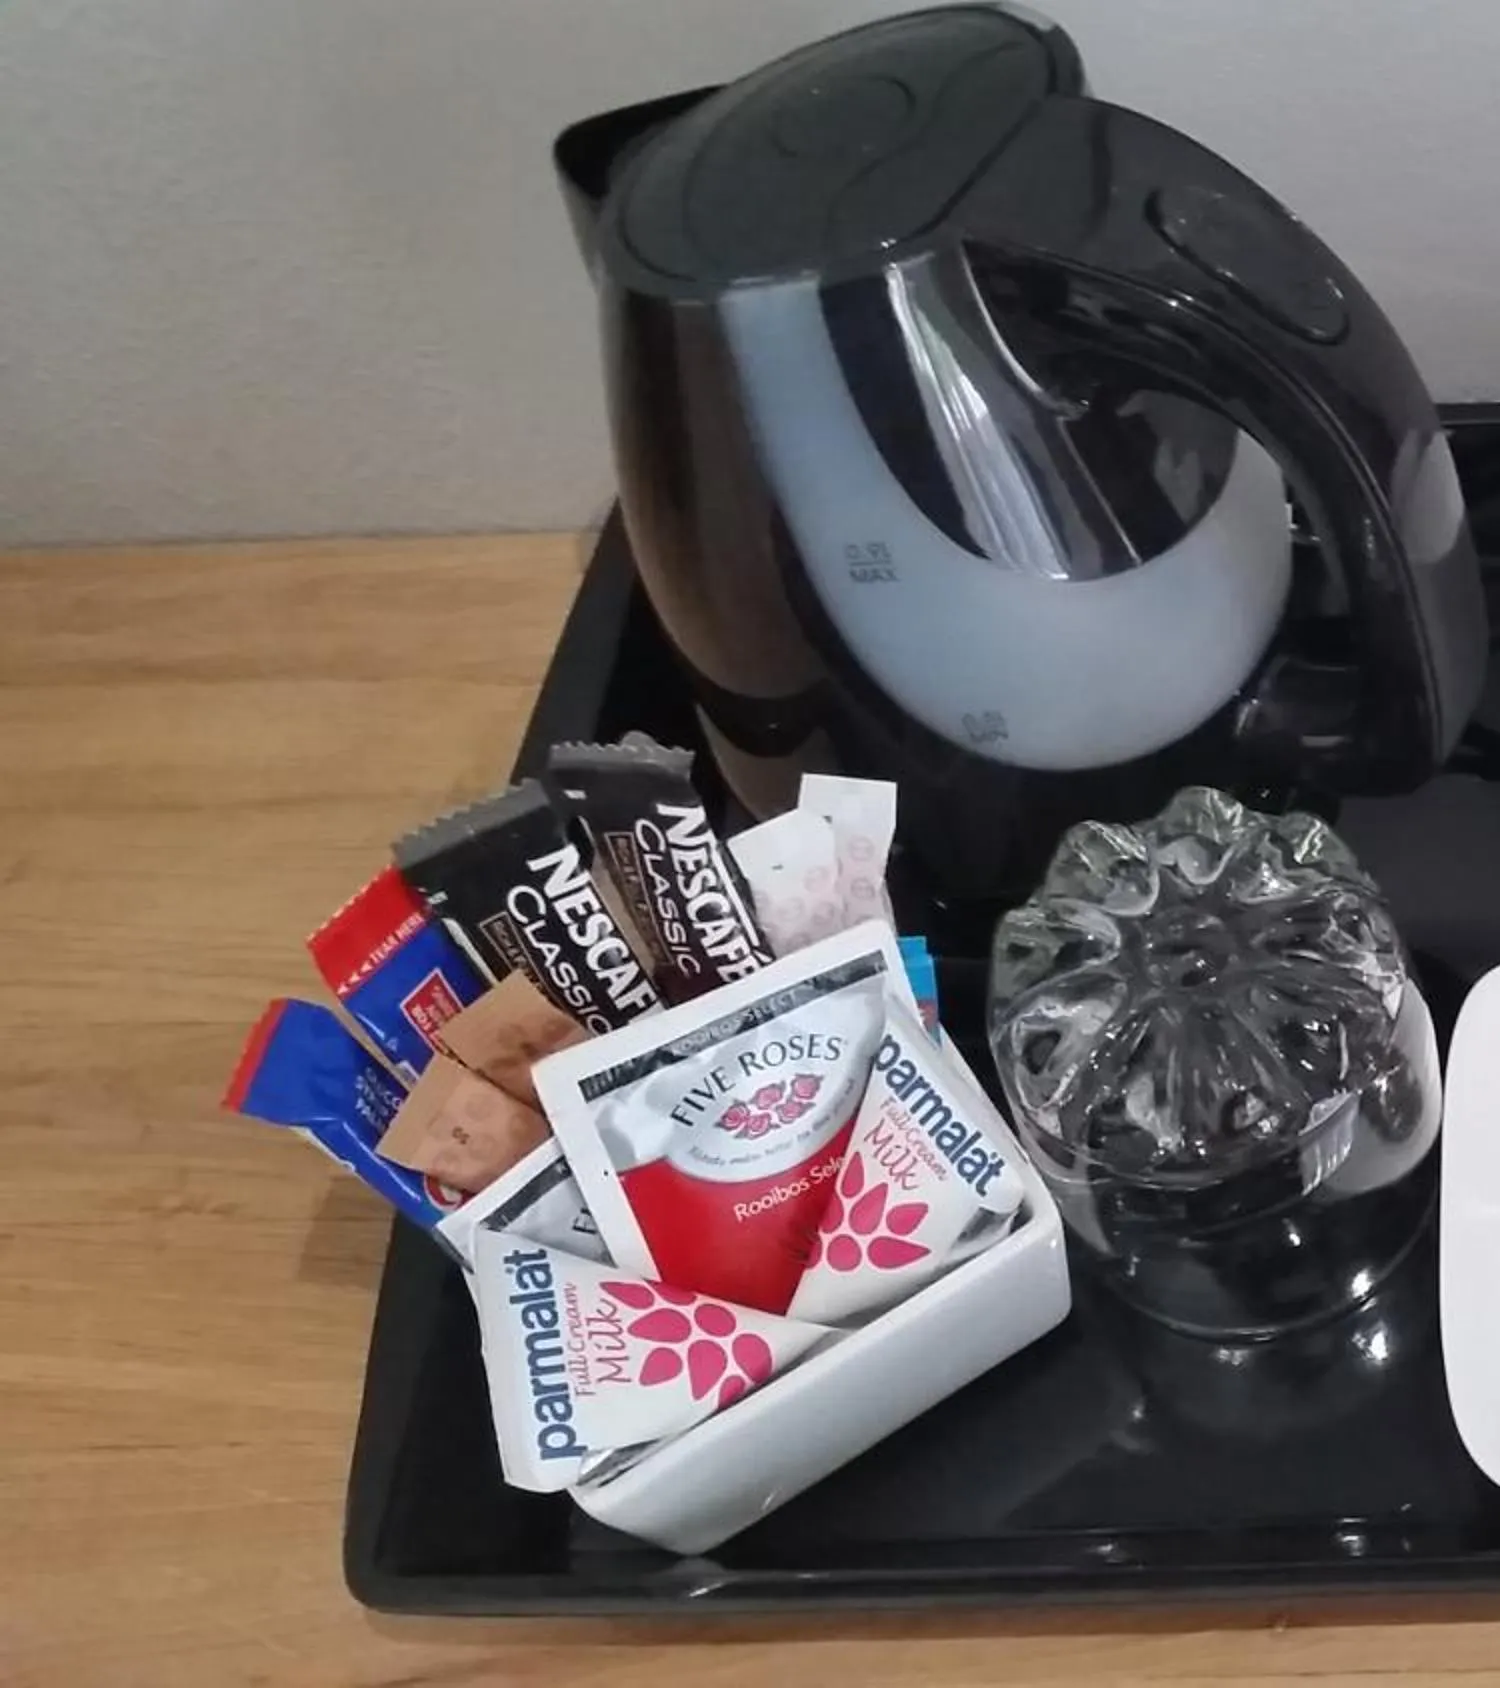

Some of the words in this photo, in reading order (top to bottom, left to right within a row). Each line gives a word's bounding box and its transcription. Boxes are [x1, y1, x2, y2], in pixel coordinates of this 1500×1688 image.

[525, 844, 657, 1011] NESCAF
[635, 819, 701, 978] CLASSIC
[507, 885, 612, 1037] CLASSIC
[670, 1066, 736, 1127] FIVE
[737, 1033, 842, 1077] ROSES
[874, 1033, 1006, 1198] parmalat
[863, 1118, 919, 1191] Milk
[880, 1096, 912, 1131] Full
[905, 1126, 948, 1181] Cream
[732, 1177, 810, 1222] Rooibos
[809, 1156, 847, 1185] Sele
[504, 1248, 589, 1461] parmalat
[563, 1282, 588, 1352] Cream
[586, 1297, 633, 1384] Milk
[568, 1353, 597, 1398] Full
